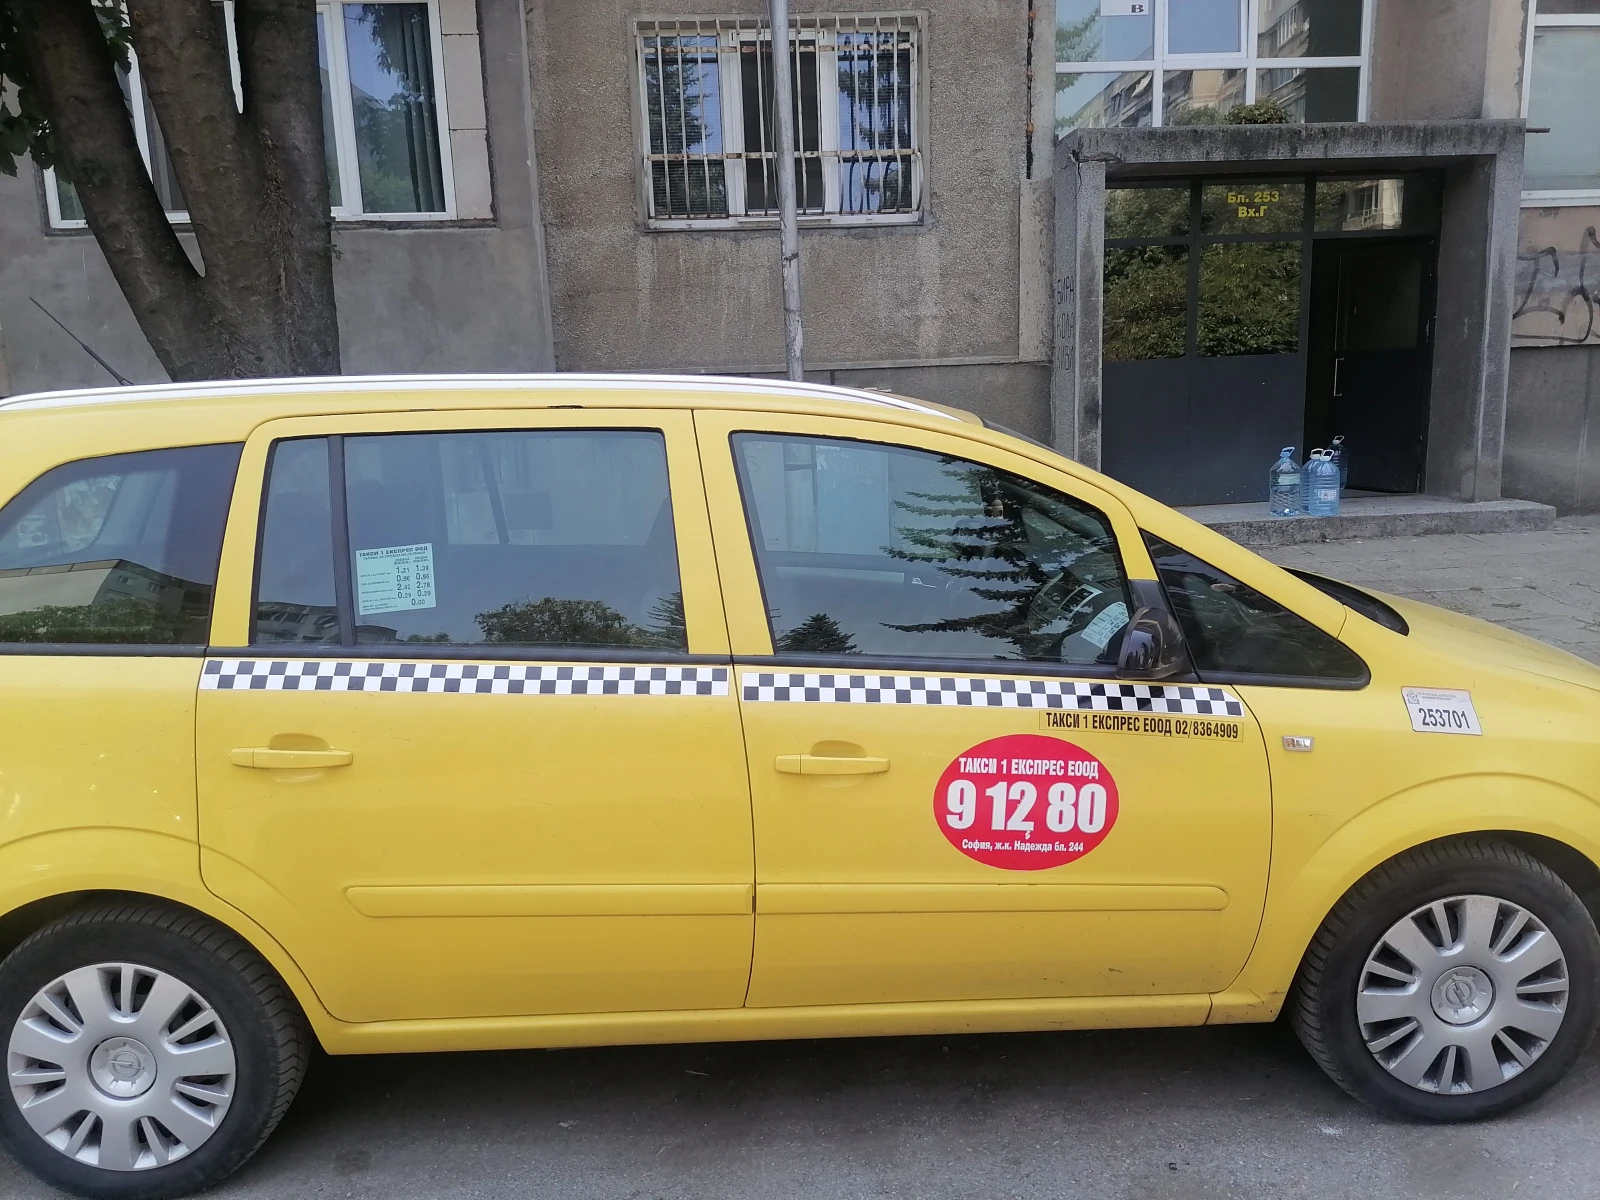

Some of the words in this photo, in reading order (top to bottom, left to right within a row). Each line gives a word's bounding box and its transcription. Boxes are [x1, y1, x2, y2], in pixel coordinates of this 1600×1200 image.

[1227, 192, 1250, 204] Бл.
[1253, 190, 1280, 203] 253
[1238, 205, 1268, 218] Вх.Г
[386, 547, 414, 555] ЕКСПРЕС
[396, 566, 410, 574] 1.21
[1046, 712, 1080, 729] ТАКСИ
[1082, 714, 1088, 729] 1
[1092, 714, 1140, 732] ЕКСПРЕС
[1143, 717, 1172, 737] ЕООД
[1175, 719, 1238, 739] 02/8364909
[1418, 707, 1470, 729] 253701
[959, 757, 997, 774] ТАКСИ
[1001, 758, 1007, 775] 1
[1011, 758, 1064, 776] ЕКСПРЕС
[1068, 760, 1099, 780] ЕООД
[946, 779, 977, 830] 9
[985, 781, 1037, 831] 12
[1046, 782, 1107, 834] 80
[962, 838, 993, 852] София,
[994, 841, 1012, 850] ж.к.
[1014, 840, 1053, 853] Надежда
[1054, 840, 1067, 852] бл.
[1068, 841, 1084, 852] 244
